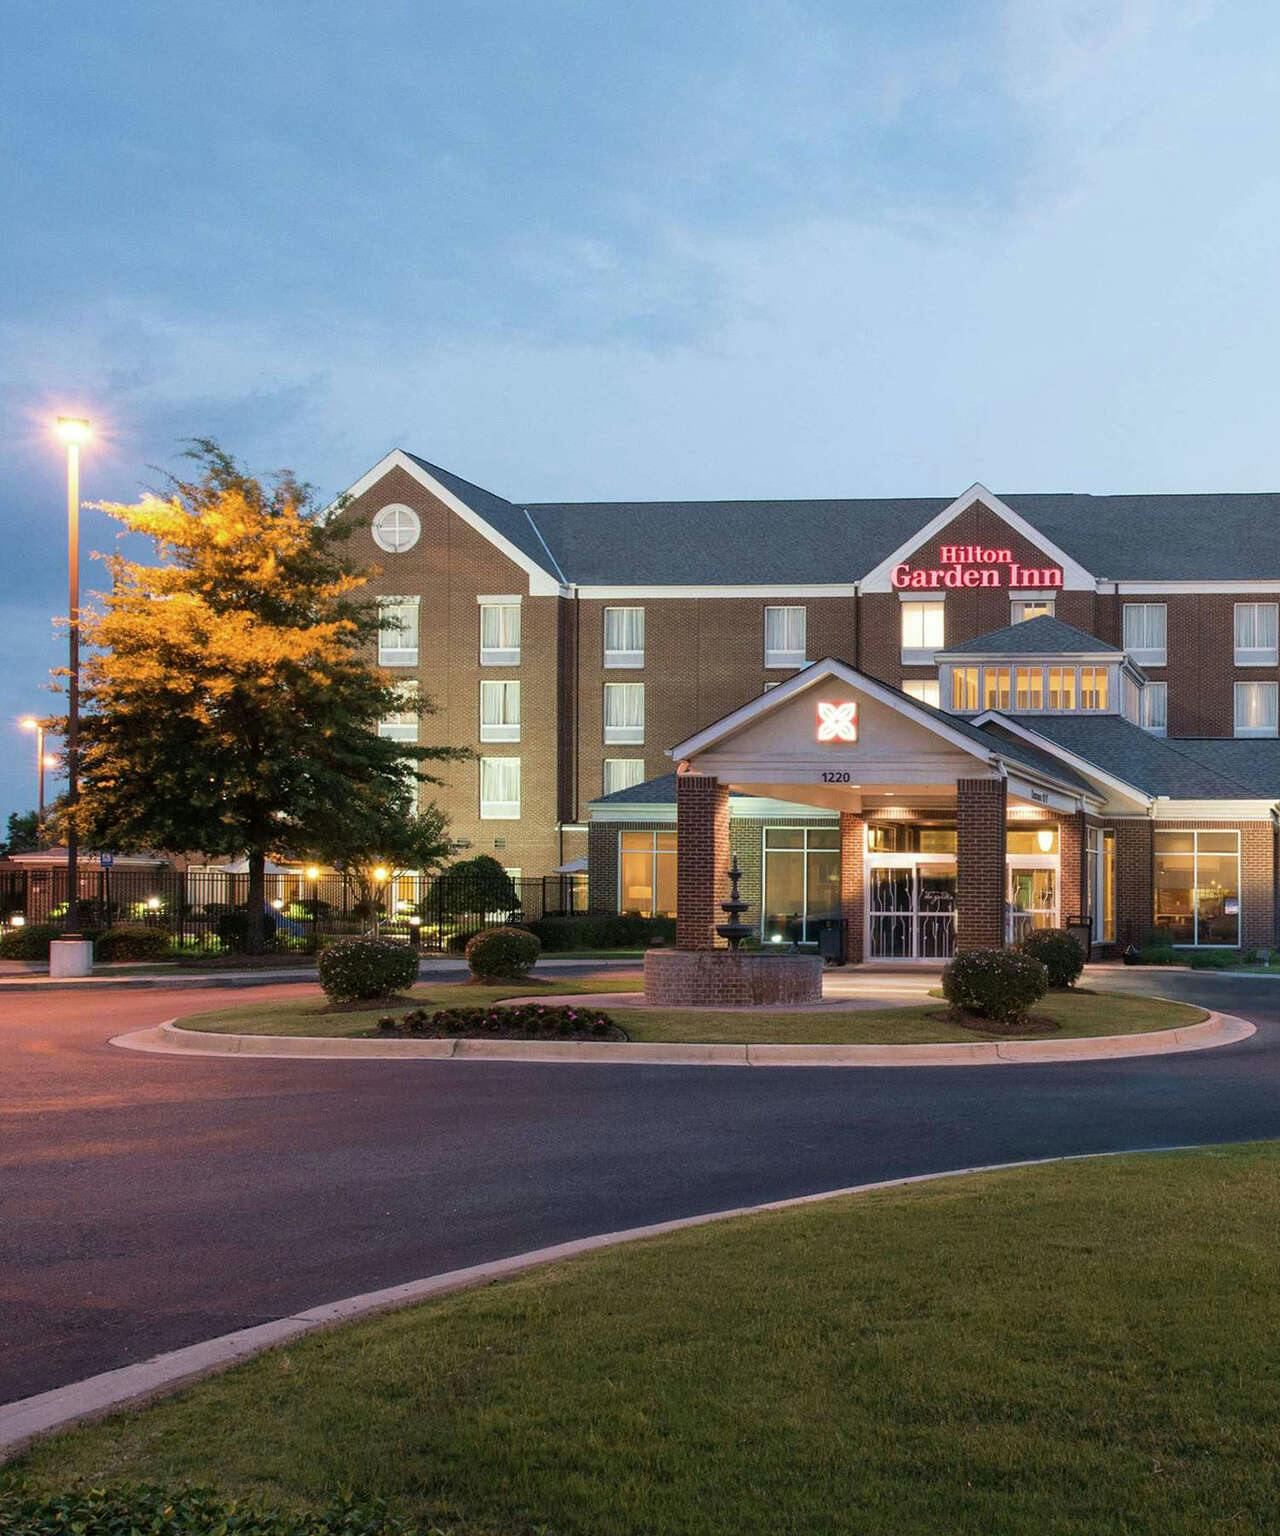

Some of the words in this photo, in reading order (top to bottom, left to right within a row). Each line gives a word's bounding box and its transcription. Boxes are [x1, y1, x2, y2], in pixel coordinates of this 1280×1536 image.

[940, 546, 1013, 564] Hilton
[891, 565, 1001, 588] Garden
[1009, 564, 1064, 587] Inn
[821, 771, 851, 783] 1220
